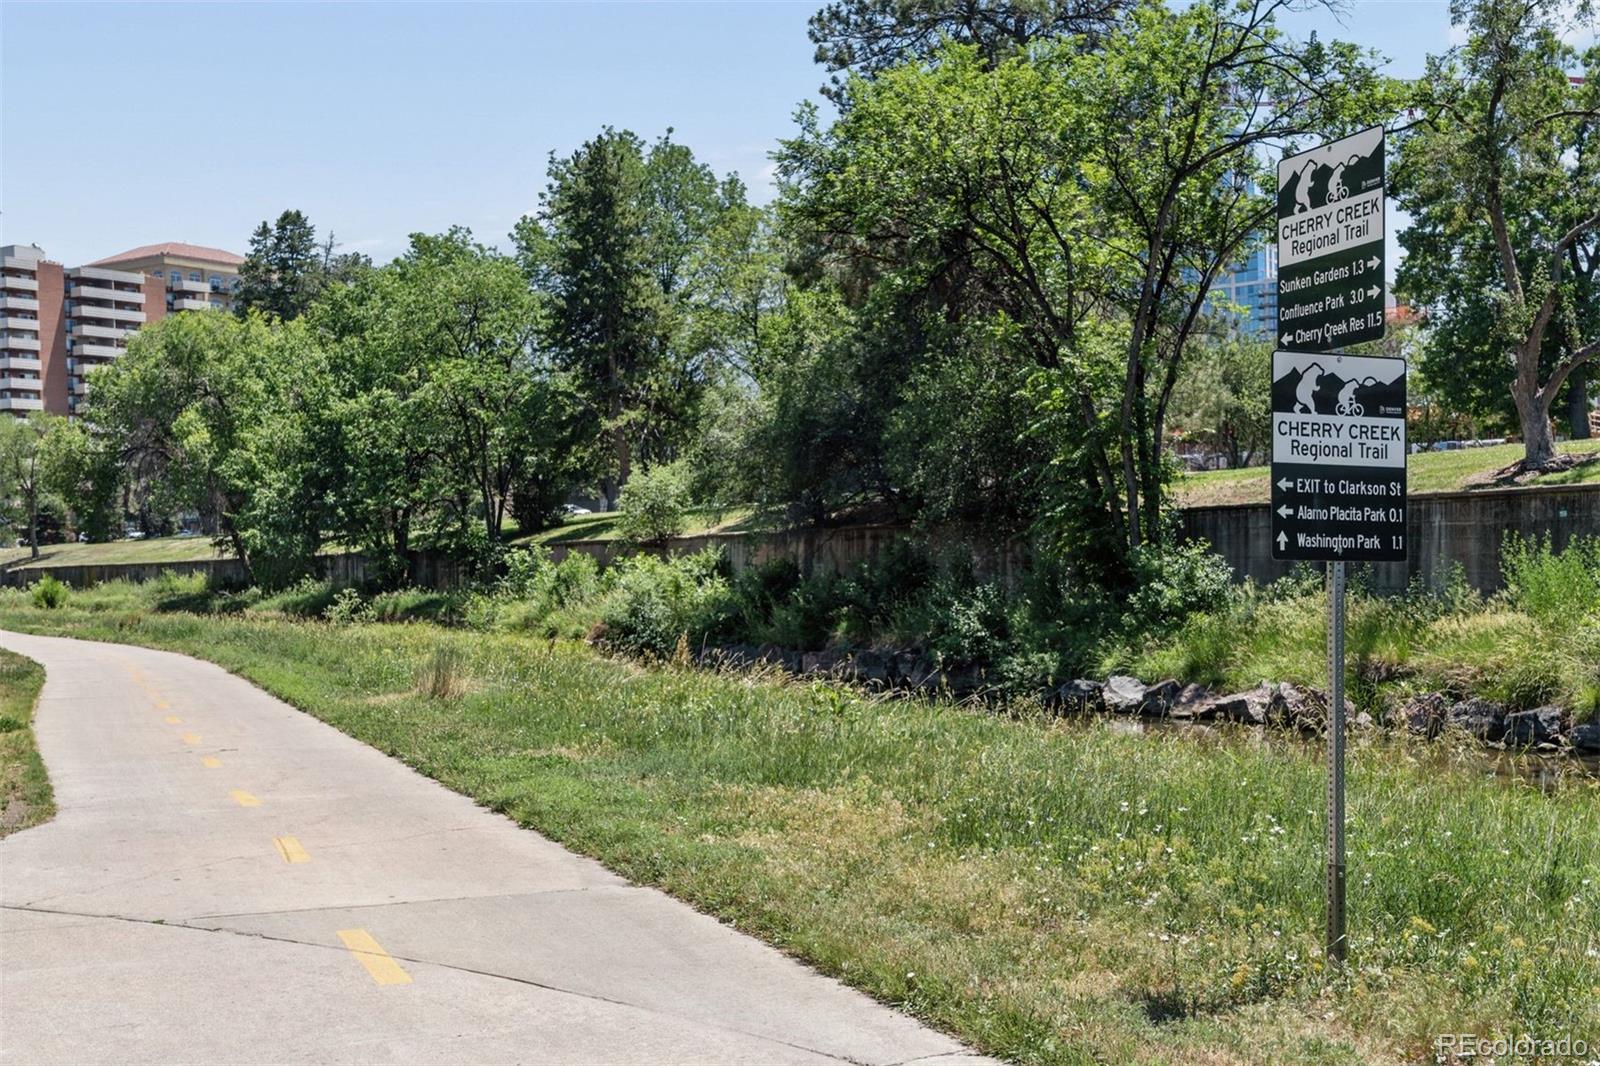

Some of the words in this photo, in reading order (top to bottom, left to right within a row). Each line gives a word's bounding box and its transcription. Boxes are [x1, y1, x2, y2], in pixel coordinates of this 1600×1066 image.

[1281, 211, 1333, 240] CHERRY
[1336, 197, 1380, 224] CREEK
[1291, 228, 1339, 256] Regional
[1344, 219, 1369, 241] Trail
[1280, 276, 1311, 294] Sunken
[1313, 266, 1349, 285] Gardens
[1352, 259, 1364, 276] 1.3
[1280, 301, 1323, 321] Confluence
[1325, 293, 1344, 311] Park
[1350, 288, 1364, 304] 3.0
[1295, 327, 1323, 344] Cherry
[1324, 320, 1348, 337] Creek
[1349, 317, 1365, 332] Res
[1367, 311, 1382, 328] 11.5
[1277, 420, 1344, 439] CHERRY
[1348, 424, 1401, 441] CREEK
[1291, 439, 1352, 461] Regional
[1358, 442, 1388, 459] Trail
[1296, 478, 1320, 493] EXIT
[1323, 481, 1335, 494] to
[1338, 480, 1386, 496] Clarkson
[1389, 481, 1401, 496] St
[1297, 505, 1328, 520] Alamo
[1330, 505, 1362, 521] Placita
[1363, 507, 1386, 522] Park
[1389, 508, 1403, 523] 0.1
[1296, 532, 1355, 552] Washington
[1357, 534, 1381, 549] Park
[1392, 535, 1403, 550] 1.1
